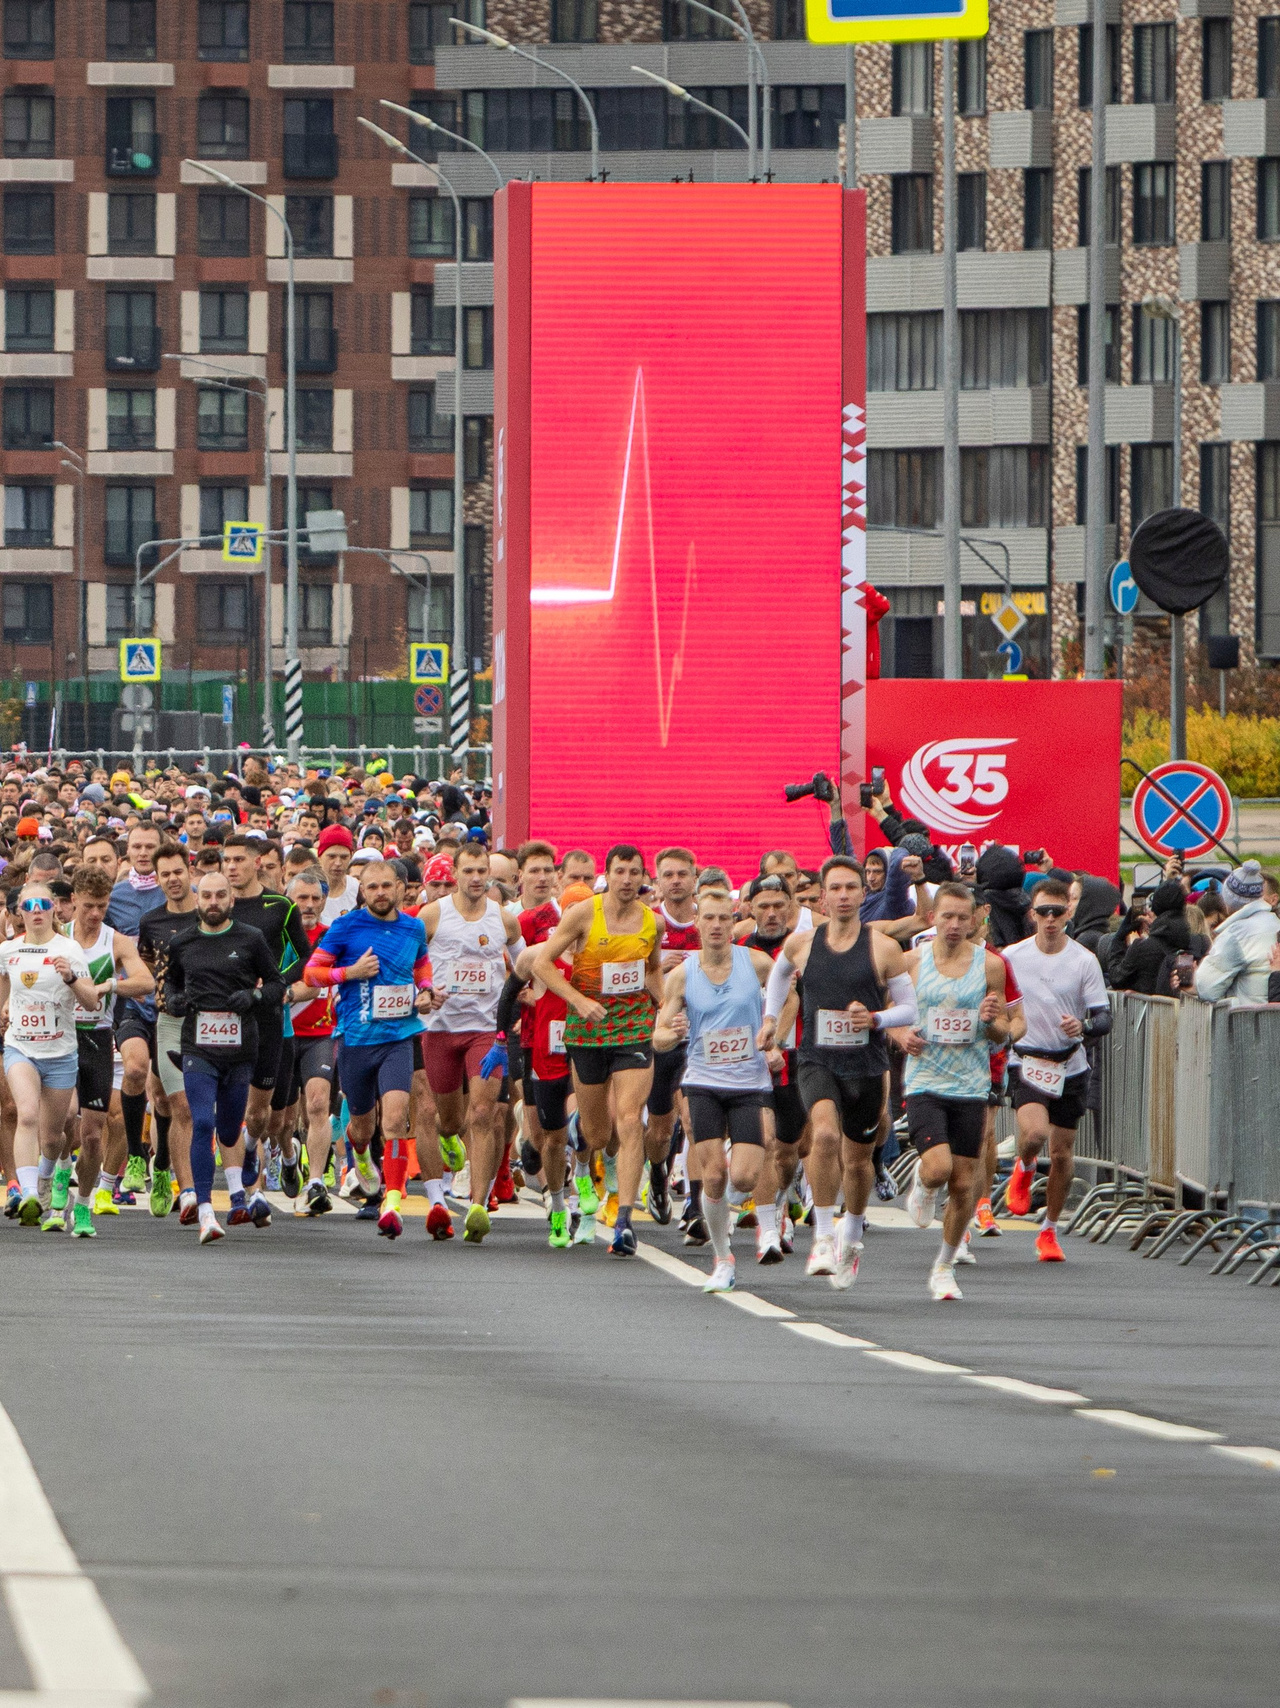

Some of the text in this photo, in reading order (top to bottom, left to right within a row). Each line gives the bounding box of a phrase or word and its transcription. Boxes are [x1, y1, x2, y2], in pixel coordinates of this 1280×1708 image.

[938, 754, 1009, 805] 35
[454, 969, 487, 983] 1758
[611, 970, 639, 986] 863
[378, 995, 411, 1009] 2284
[21, 1014, 47, 1028] 891
[934, 1018, 972, 1032] 1332
[200, 1022, 239, 1036] 2448
[709, 1037, 749, 1055] 2627
[1026, 1066, 1062, 1086] 2537
